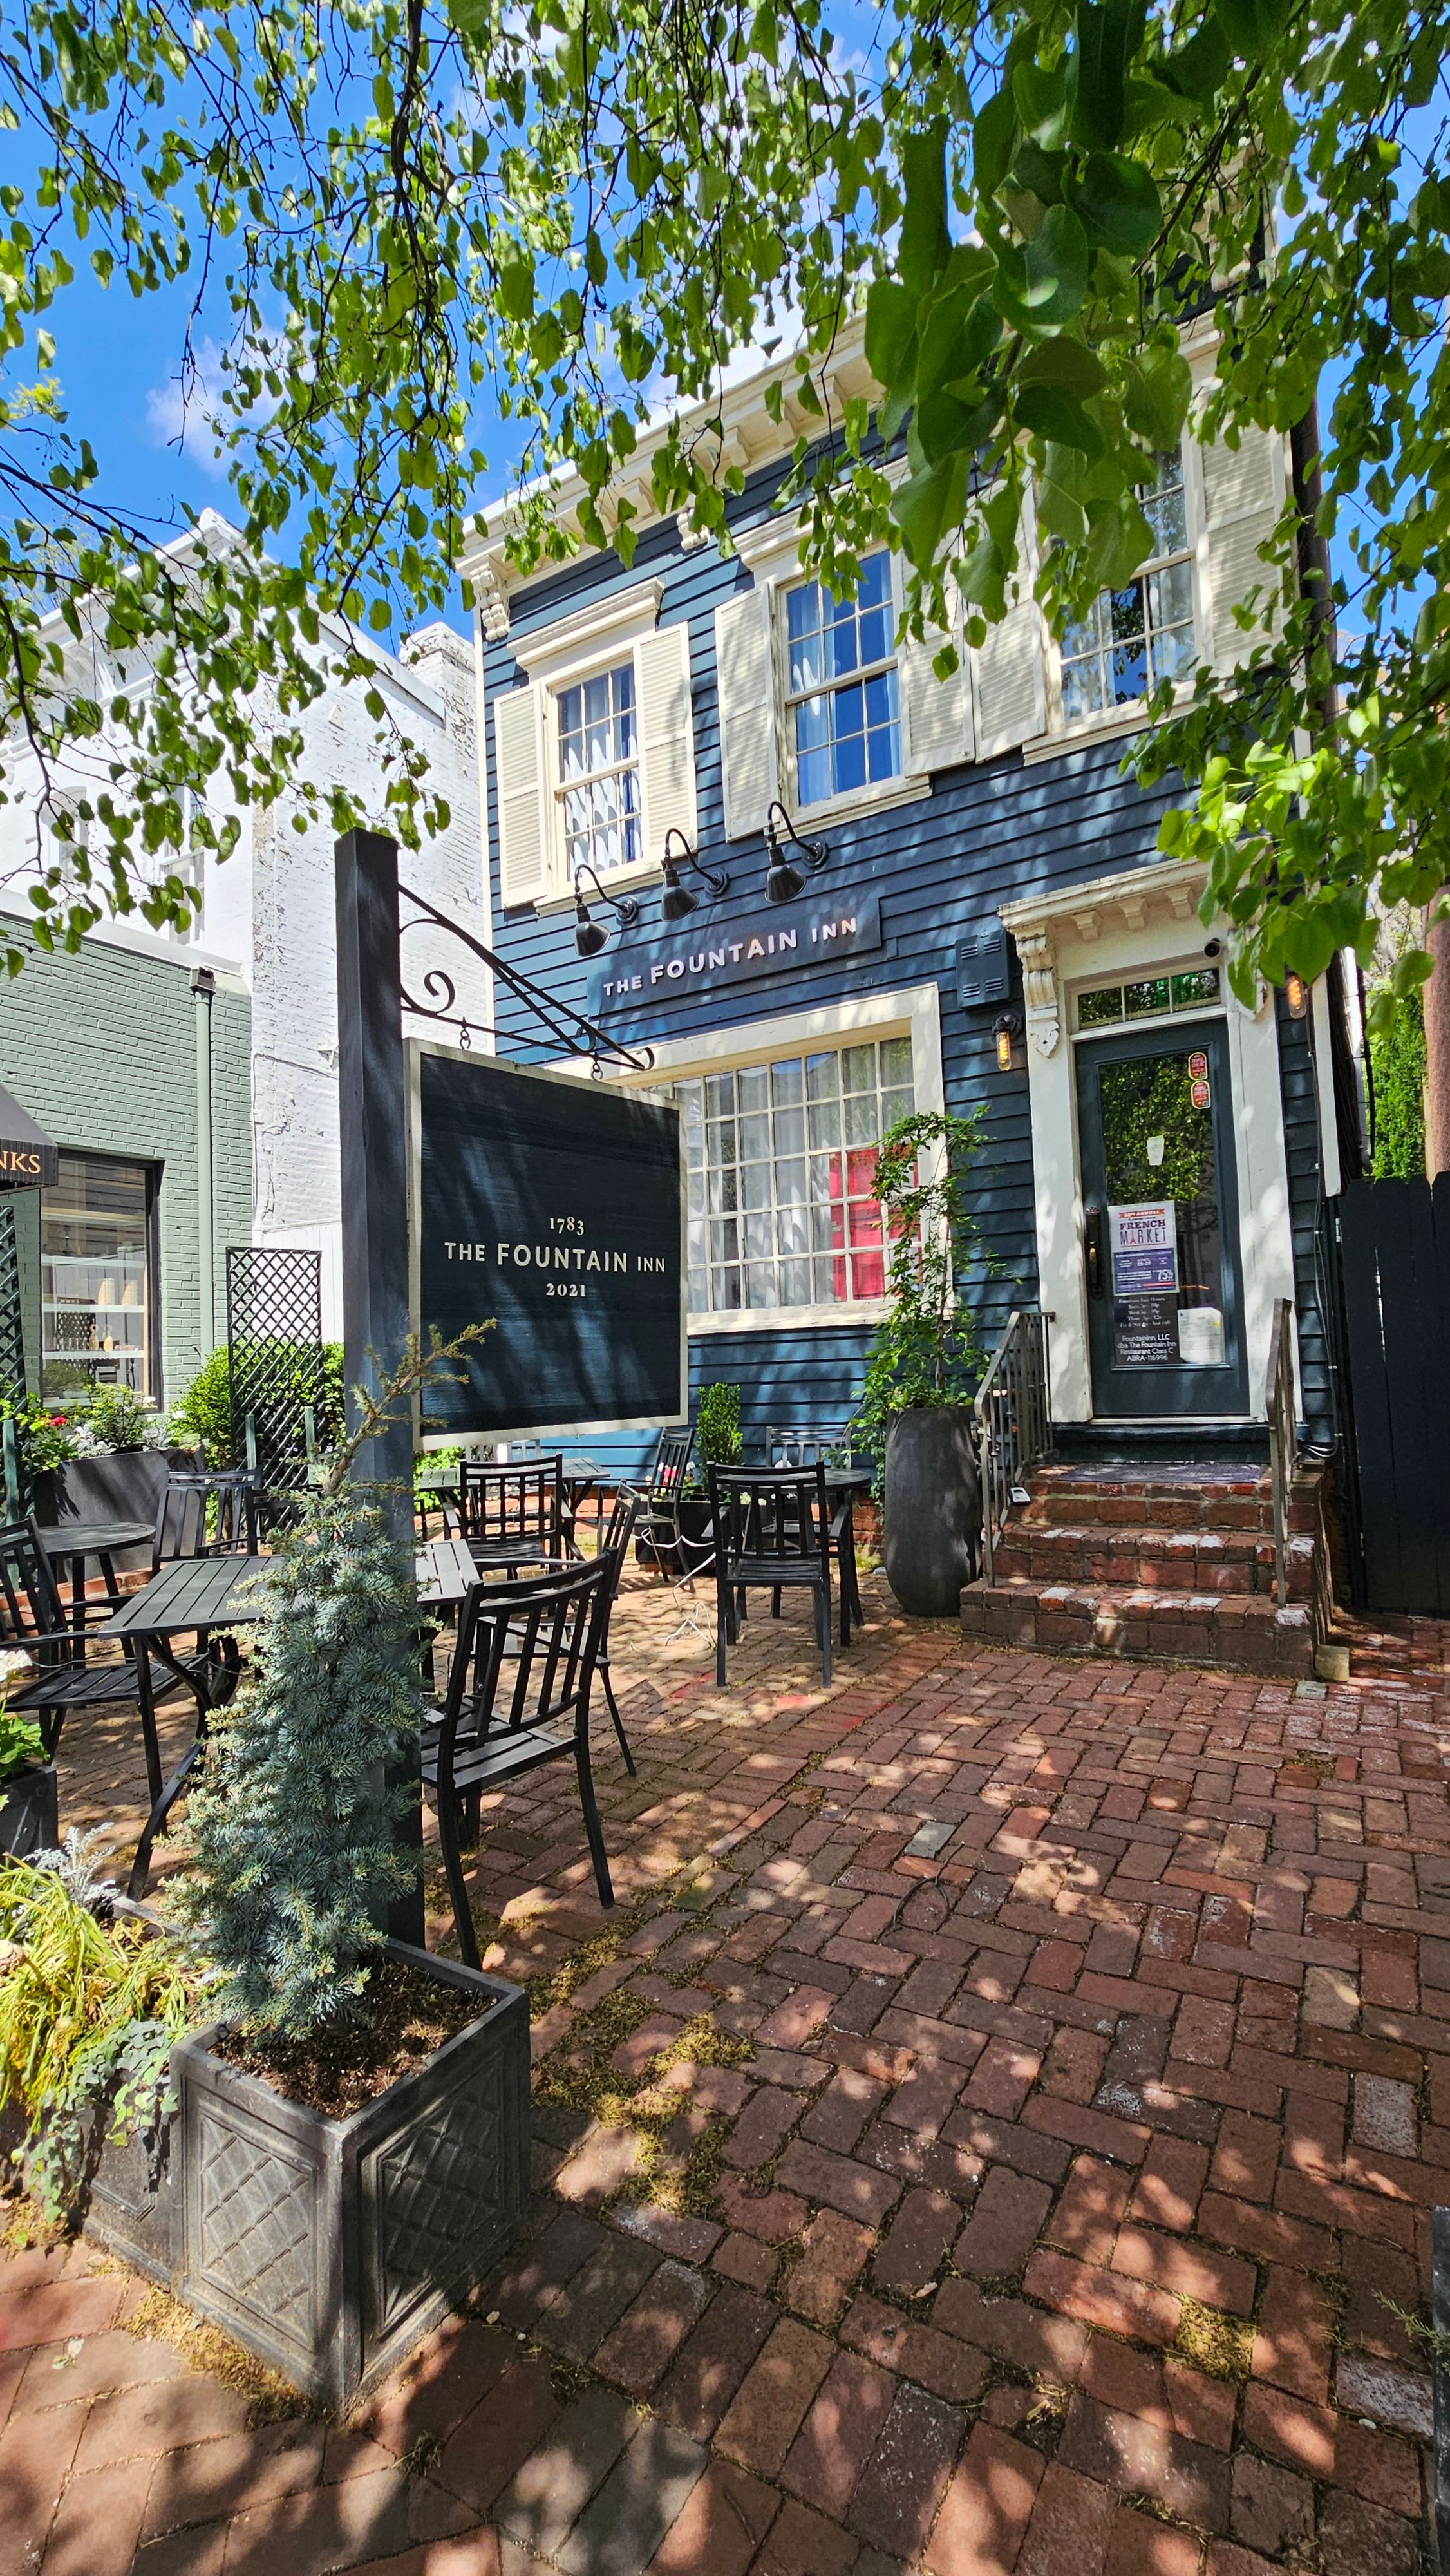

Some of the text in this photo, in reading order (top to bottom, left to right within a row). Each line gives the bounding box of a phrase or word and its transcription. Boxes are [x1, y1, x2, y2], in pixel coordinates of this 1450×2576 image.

[603, 917, 858, 997] THE FOUNTAIN INN
[549, 1217, 585, 1236] 1783
[1120, 1219, 1166, 1230] FRENCH
[1120, 1227, 1167, 1245] MARKET
[444, 1242, 665, 1273] THE FOUNTAIN INN
[1158, 1269, 1174, 1280] 75%
[546, 1283, 587, 1298] 2021
